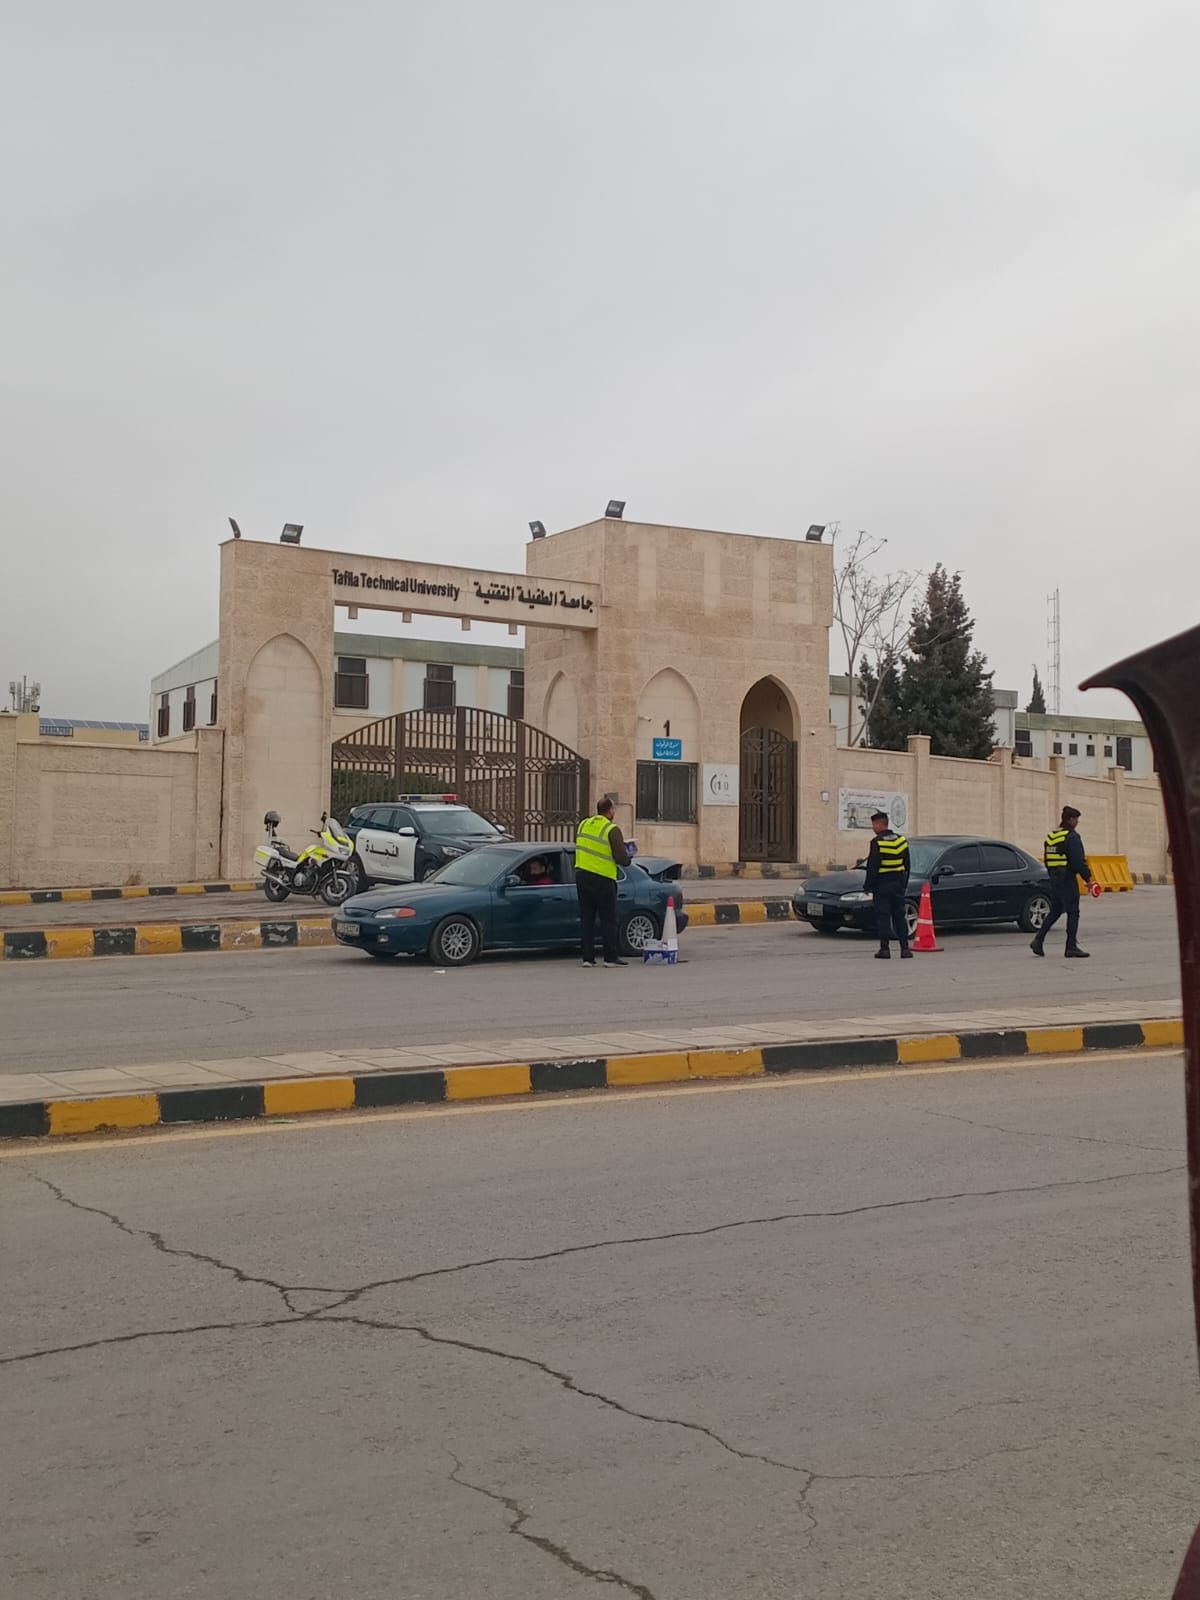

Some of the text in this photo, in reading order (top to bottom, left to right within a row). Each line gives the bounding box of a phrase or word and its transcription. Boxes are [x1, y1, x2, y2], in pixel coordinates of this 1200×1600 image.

[332, 569, 460, 602] Tafila Technical University
[473, 581, 593, 613] جامعة الطفيلة التقنية
[663, 720, 670, 737] 1
